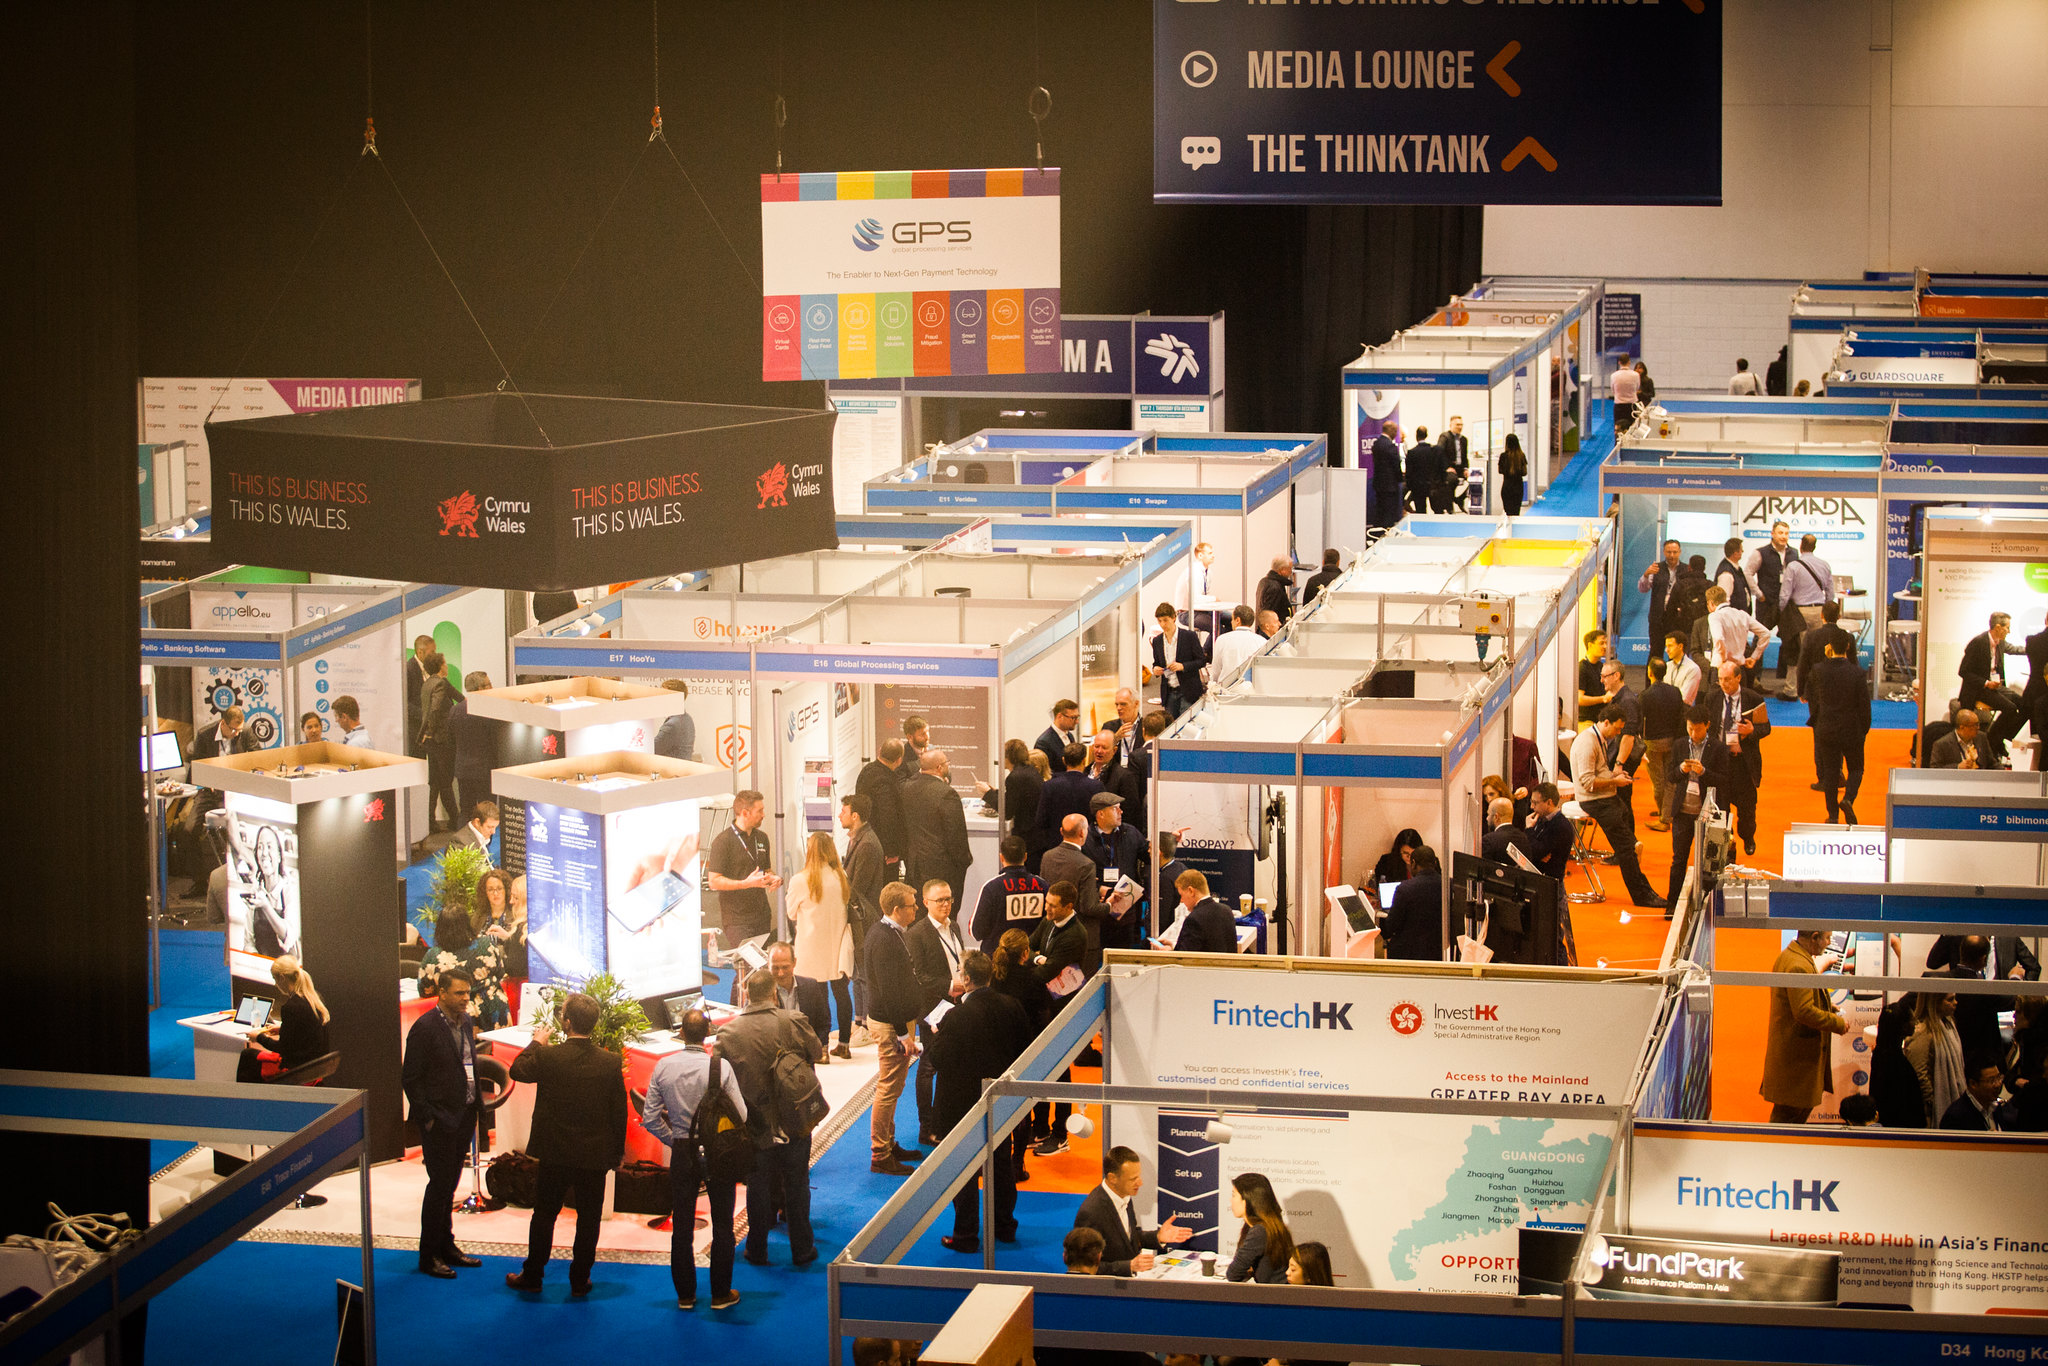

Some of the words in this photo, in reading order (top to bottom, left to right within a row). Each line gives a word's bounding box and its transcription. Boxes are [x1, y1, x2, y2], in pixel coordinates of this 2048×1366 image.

[1248, 51, 1345, 88] MEDIA
[1355, 51, 1474, 88] LOUNGE
[1248, 135, 1305, 172] THE
[1315, 135, 1490, 172] THINKTANK
[892, 221, 972, 243] GPS
[913, 246, 946, 254] processing
[843, 271, 872, 279] Enabler
[883, 269, 919, 278] Next-Gen
[922, 268, 954, 279] Payment
[956, 267, 998, 277] Technology
[1937, 307, 1965, 315] illumio
[1501, 315, 1550, 325] ondo
[1060, 339, 1113, 373] MA
[1860, 371, 1944, 383] GUARDSQUARE
[297, 387, 347, 409] MEDIA
[792, 463, 823, 480] Cymru
[229, 472, 264, 497] THIS
[269, 476, 282, 498] IS
[286, 478, 371, 504] BUSINESS.
[571, 487, 607, 511] THIS
[611, 484, 624, 506] IS
[628, 472, 703, 502] BUSINESS.
[793, 483, 821, 498] Wales
[485, 497, 530, 516] Cymru
[1145, 498, 1168, 506] Swaper
[229, 499, 264, 522] THIS
[269, 503, 282, 524] IS
[286, 504, 350, 530] WALES.
[572, 515, 608, 539] THIS
[611, 512, 624, 534] IS
[628, 502, 685, 530] WALES.
[486, 517, 525, 534] Wales
[2004, 543, 2040, 553] kompany
[212, 605, 271, 621] appello.eu
[164, 644, 193, 653] Banking
[195, 645, 226, 653] Software
[609, 654, 624, 662] E17
[629, 655, 656, 663] HooYu
[813, 659, 829, 667] E16
[834, 660, 860, 668] Global
[861, 661, 904, 671] Processing
[906, 662, 940, 670] Services
[797, 701, 820, 731] GPS
[1980, 814, 1998, 824] P52
[1003, 878, 1043, 891] U.S.A.
[1011, 896, 1039, 917] 012
[1213, 999, 1354, 1031] FintechHK
[1434, 1003, 1499, 1021] InvestHK
[1449, 1024, 1494, 1032] Government
[1520, 1027, 1540, 1035] Hong
[1541, 1027, 1561, 1035] Kong
[1434, 1032, 1459, 1040] Special
[1461, 1032, 1513, 1041] Administrative
[1515, 1034, 1540, 1043] Region
[1184, 1064, 1200, 1072] You
[1221, 1066, 1250, 1074] access
[1252, 1067, 1297, 1076] InvestHK's
[1299, 1068, 1323, 1078] free,
[1158, 1074, 1216, 1084] customised
[1219, 1077, 1239, 1085] and
[1242, 1078, 1304, 1088] confidential
[1308, 1081, 1350, 1091] services
[1445, 1072, 1486, 1082] Access
[1491, 1073, 1503, 1083] to
[1508, 1073, 1527, 1083] the
[1532, 1074, 1589, 1085] Mainland
[1171, 1128, 1206, 1140] Planning
[1287, 1126, 1316, 1135] planning
[1262, 1157, 1291, 1165] business
[1501, 1150, 1585, 1163] GUANGDONG
[1175, 1169, 1189, 1178] Set
[1191, 1171, 1202, 1180] up
[1467, 1171, 1504, 1180] Zhaoqing
[1508, 1167, 1553, 1176] Guangzhou
[1488, 1183, 1516, 1191] Foshan
[1532, 1179, 1563, 1187] Huizhou
[1524, 1187, 1565, 1195] Dongguan
[1677, 1176, 1840, 1212] FintechHK
[1475, 1195, 1518, 1204] Zhongshan
[1530, 1198, 1568, 1206] Shenzhen
[1173, 1210, 1204, 1219] Launch
[1441, 1212, 1480, 1221] Jiangmen
[1488, 1216, 1514, 1224] Macau
[1769, 1229, 1833, 1247] Largest
[1839, 1231, 1875, 1246] R&D
[1881, 1233, 1914, 1248] Hub
[1919, 1234, 1933, 1249] in
[1939, 1235, 1988, 1251] Asia's
[1994, 1237, 2048, 1253] Financ
[1608, 1246, 1745, 1281] FundPark
[1889, 1256, 1903, 1265] the
[1905, 1257, 1928, 1268] Hong
[1931, 1258, 1953, 1269] Kong
[1955, 1259, 1989, 1269] Science
[1991, 1261, 2007, 1270] and
[1474, 1273, 1497, 1283] FOR
[1844, 1266, 1860, 1275] and
[1863, 1266, 1908, 1277] innovation
[1910, 1268, 1926, 1277] hub
[1929, 1269, 1937, 1278] in
[1939, 1270, 1961, 1281] Hong
[1964, 1271, 1989, 1281] Kong.
[1992, 1272, 2022, 1281] HKSTP
[2024, 1273, 2048, 1283] helps
[1630, 1277, 1649, 1286] Trade
[1651, 1278, 1677, 1287] Finance
[1678, 1280, 1705, 1290] Platform
[1706, 1282, 1713, 1290] in
[1714, 1284, 1729, 1292] Asia
[1840, 1277, 1862, 1288] Kong
[1864, 1278, 1880, 1286] and
[1882, 1278, 1913, 1289] beyond
[1915, 1280, 1950, 1291] through
[1952, 1281, 1963, 1290] its
[1965, 1282, 1999, 1292] support
[2002, 1283, 2044, 1294] programs
[1941, 1343, 1971, 1357] D34
[1985, 1345, 2026, 1362] Hong
